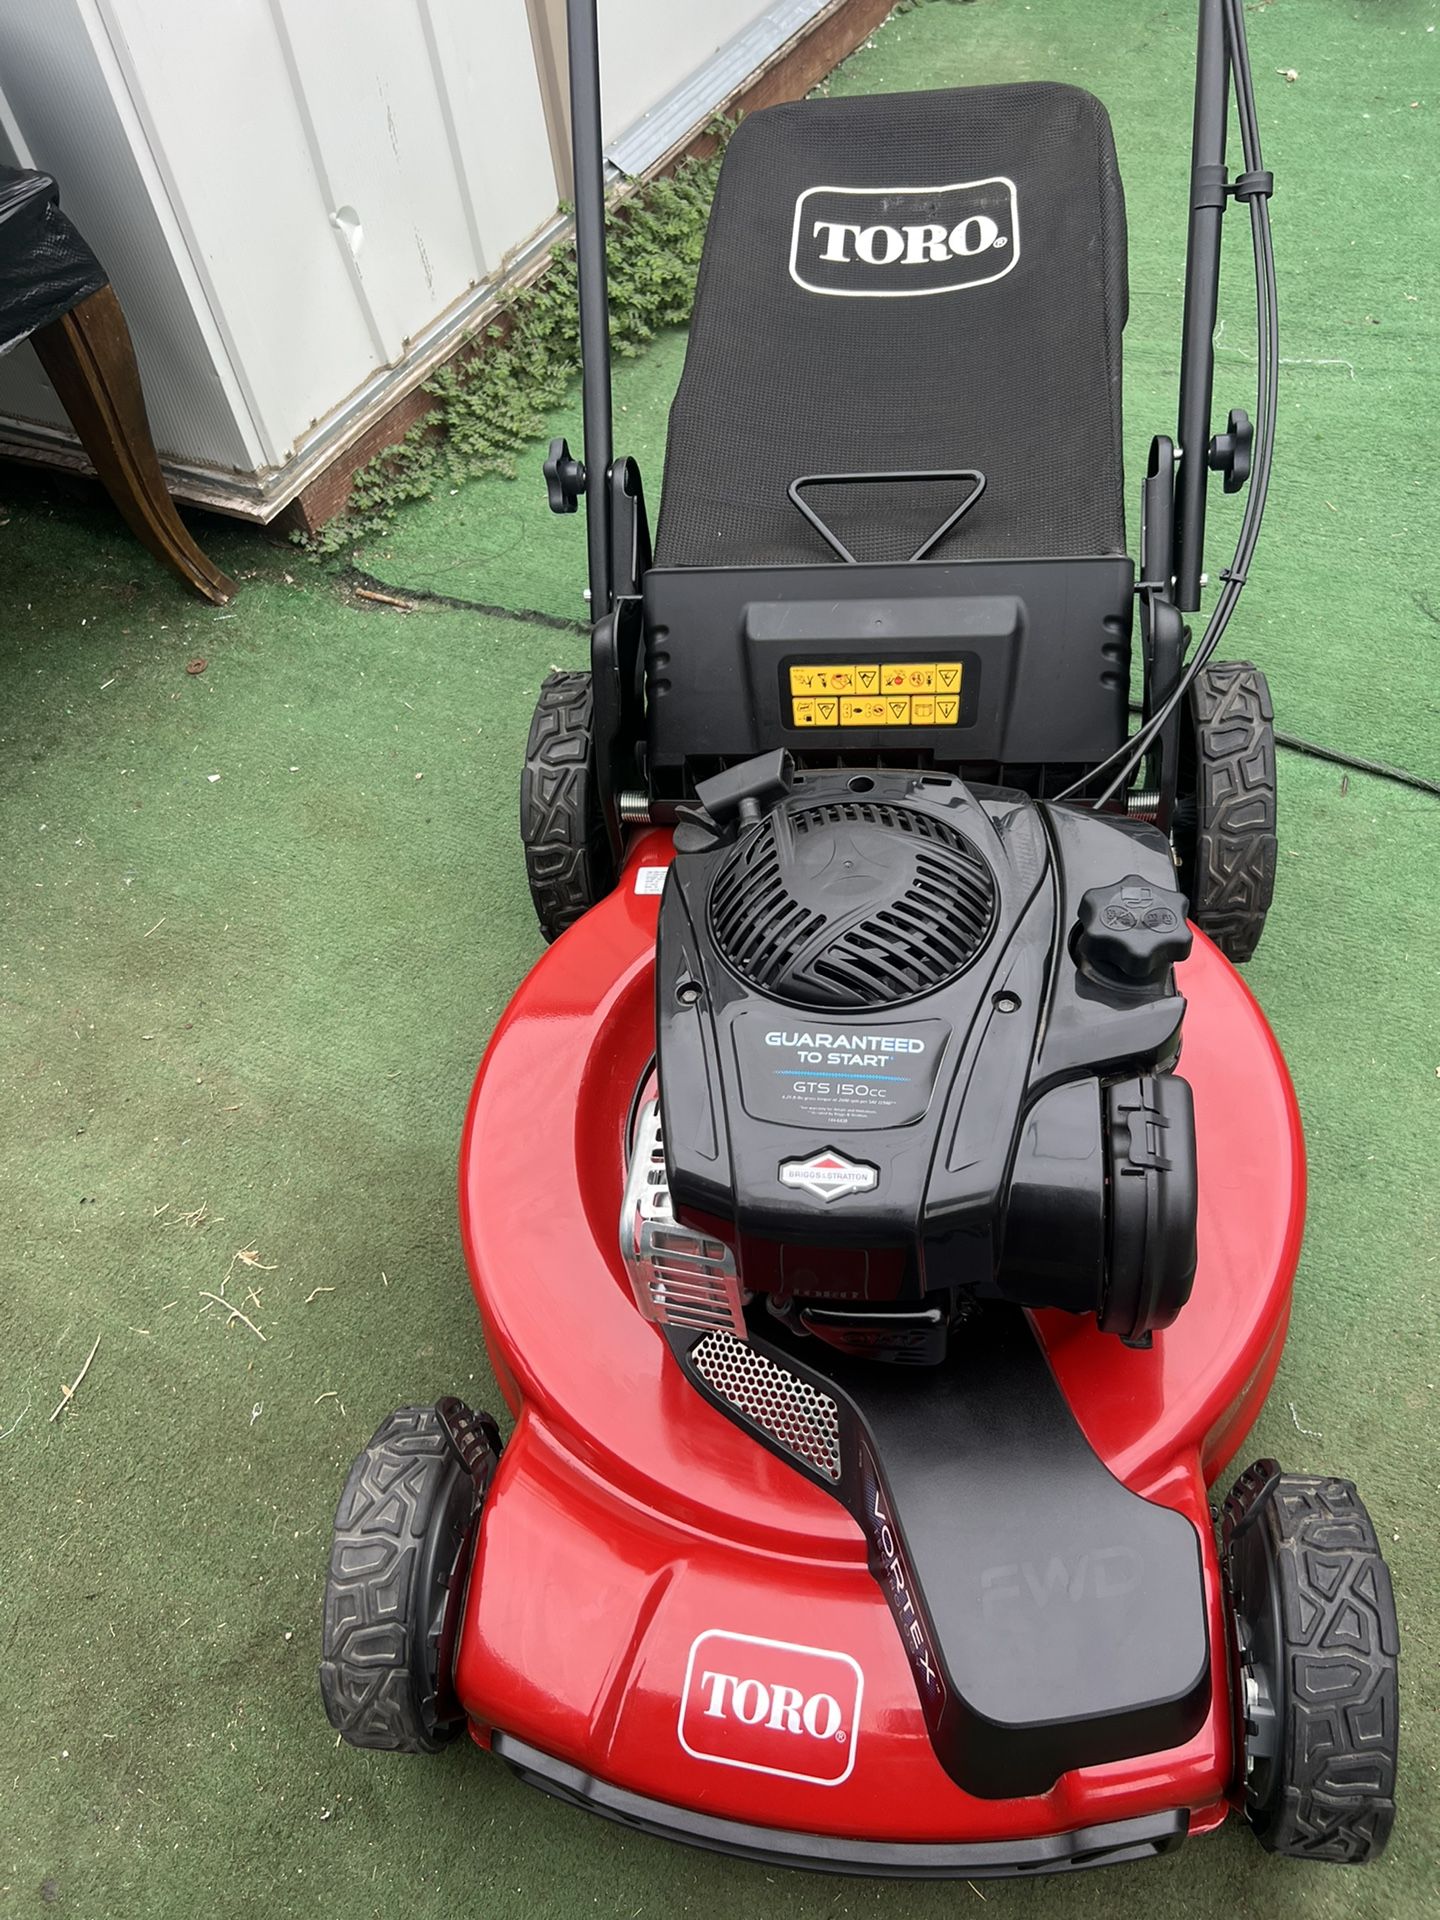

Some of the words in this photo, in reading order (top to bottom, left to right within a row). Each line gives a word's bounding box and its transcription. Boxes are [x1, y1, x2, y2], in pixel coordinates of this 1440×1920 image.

[813, 215, 998, 265] TORO
[764, 1031, 925, 1054] GUARANTEED
[797, 1051, 822, 1064] TO
[826, 1052, 889, 1067] START
[793, 1081, 830, 1095] GTS
[836, 1083, 887, 1098] 150cc
[873, 1491, 936, 1684] VORTEX
[978, 1544, 1145, 1624] FWD
[701, 1670, 842, 1739] TORO
